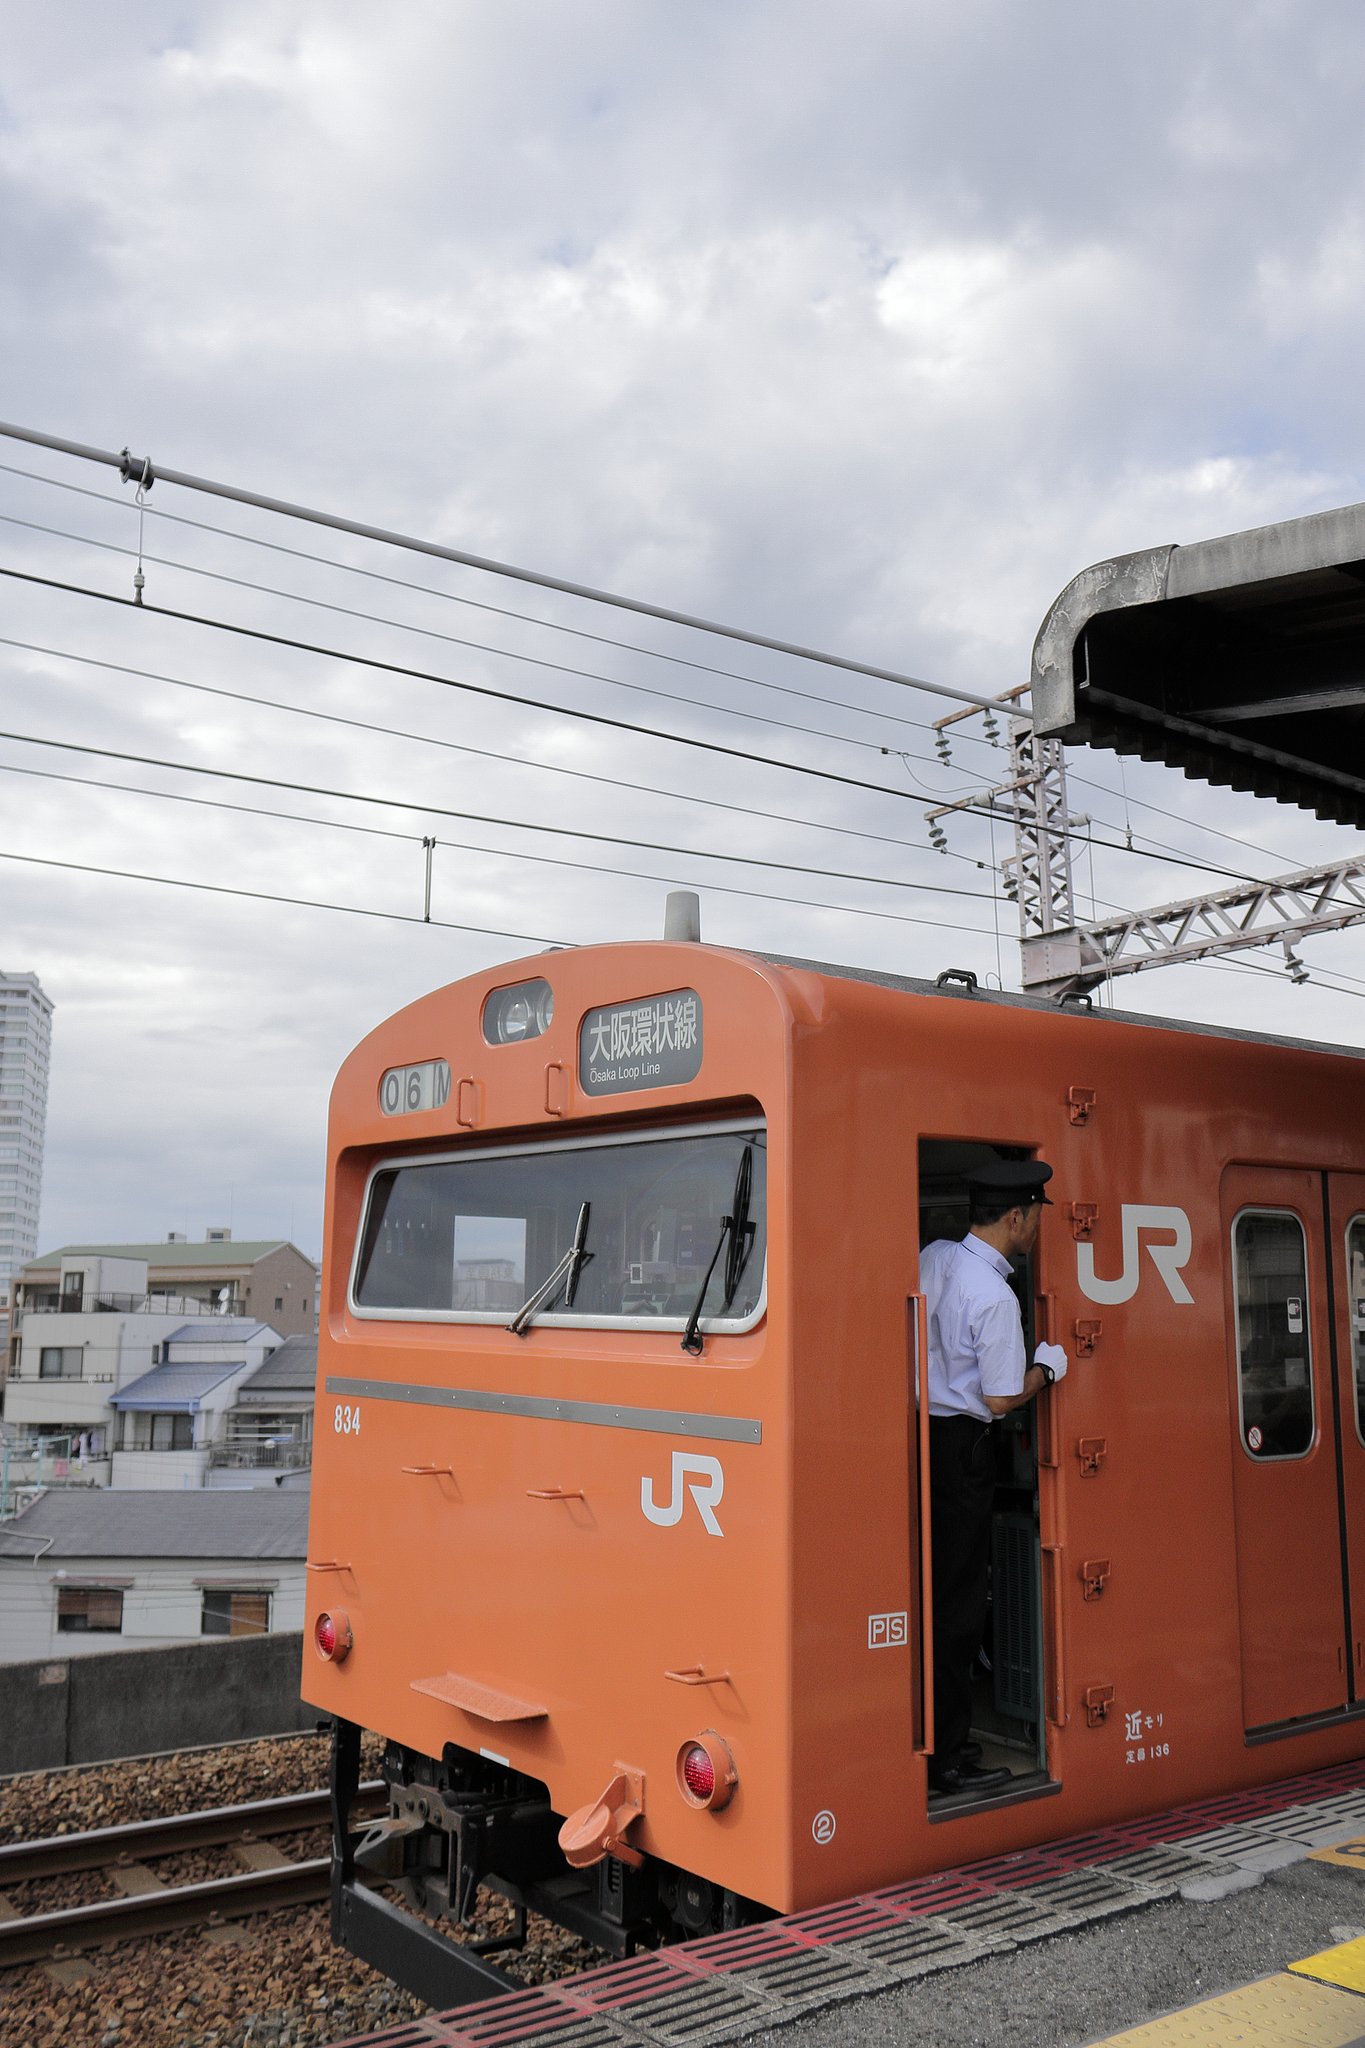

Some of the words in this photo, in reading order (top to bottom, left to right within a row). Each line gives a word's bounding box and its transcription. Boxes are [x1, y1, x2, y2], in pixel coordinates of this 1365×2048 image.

[589, 997, 697, 1063] 大阪環状線
[618, 1066, 639, 1080] Loop
[641, 1062, 660, 1076] Line
[1076, 1203, 1196, 1305] JR
[334, 1404, 360, 1436] 834
[641, 1451, 725, 1538] JR
